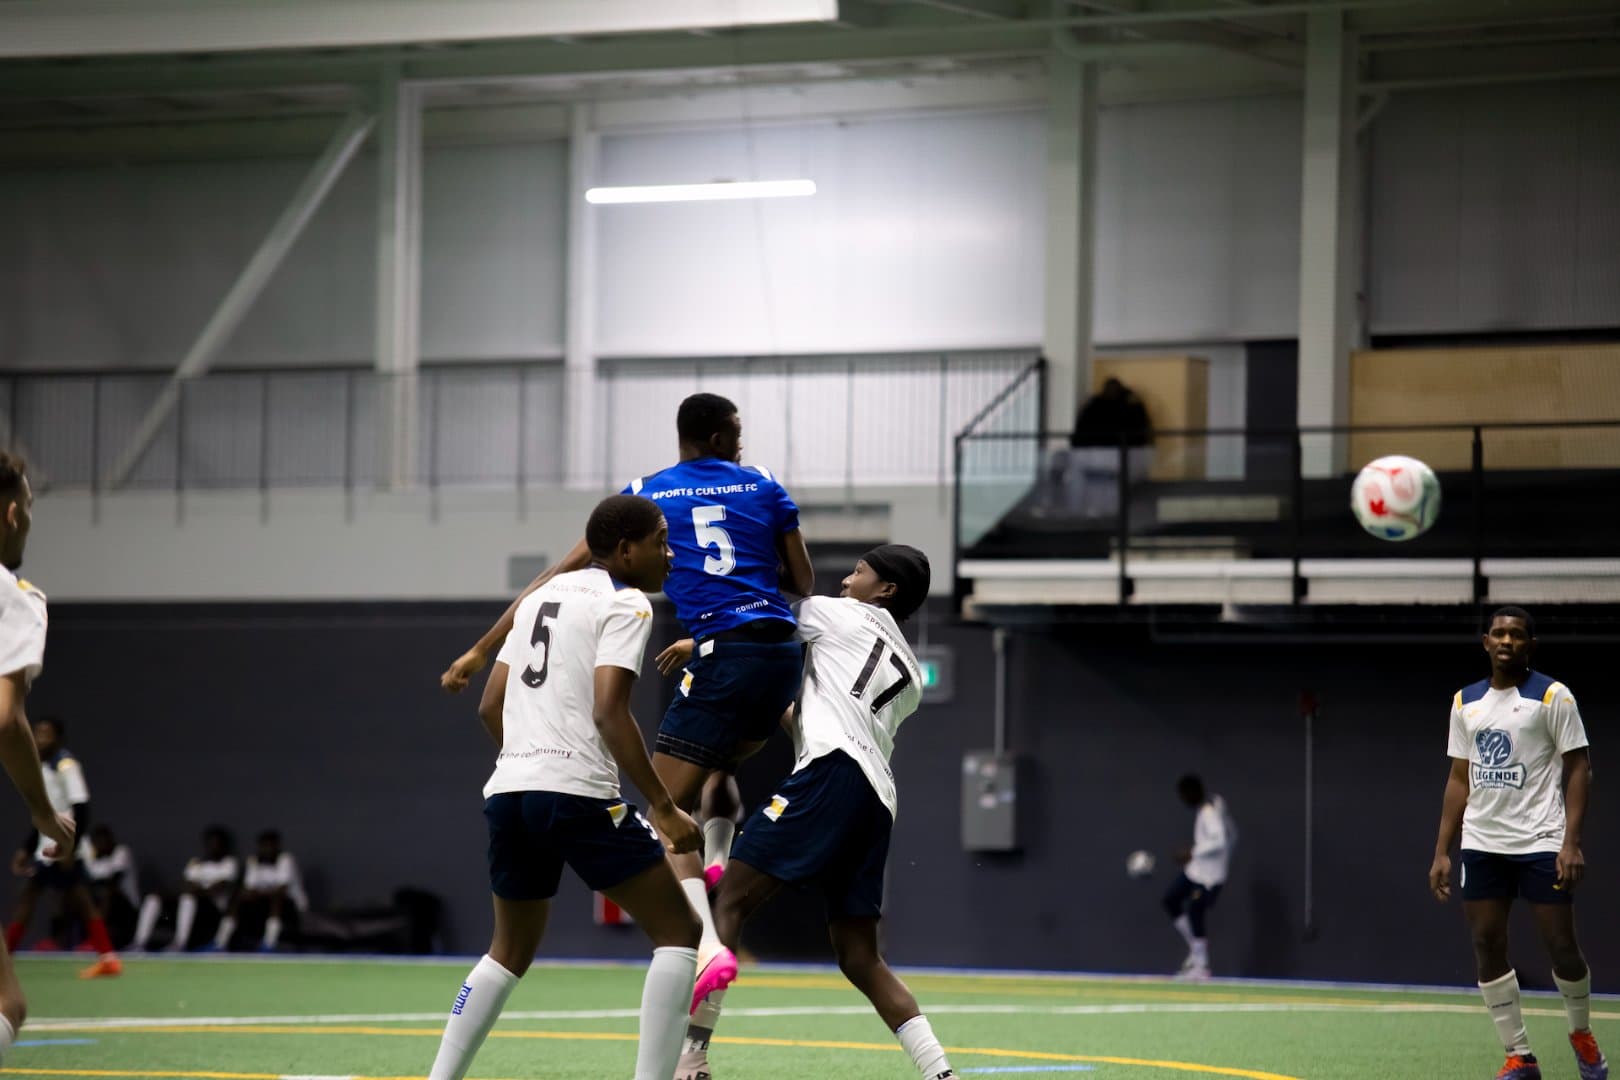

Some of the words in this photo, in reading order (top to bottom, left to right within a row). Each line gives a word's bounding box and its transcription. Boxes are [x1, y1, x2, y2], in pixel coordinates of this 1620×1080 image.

[652, 487, 693, 500] SPORTS
[695, 484, 744, 497] CULTURE
[745, 483, 759, 492] FC
[691, 505, 736, 577] 5
[521, 601, 561, 689] 5
[850, 637, 912, 715] 17
